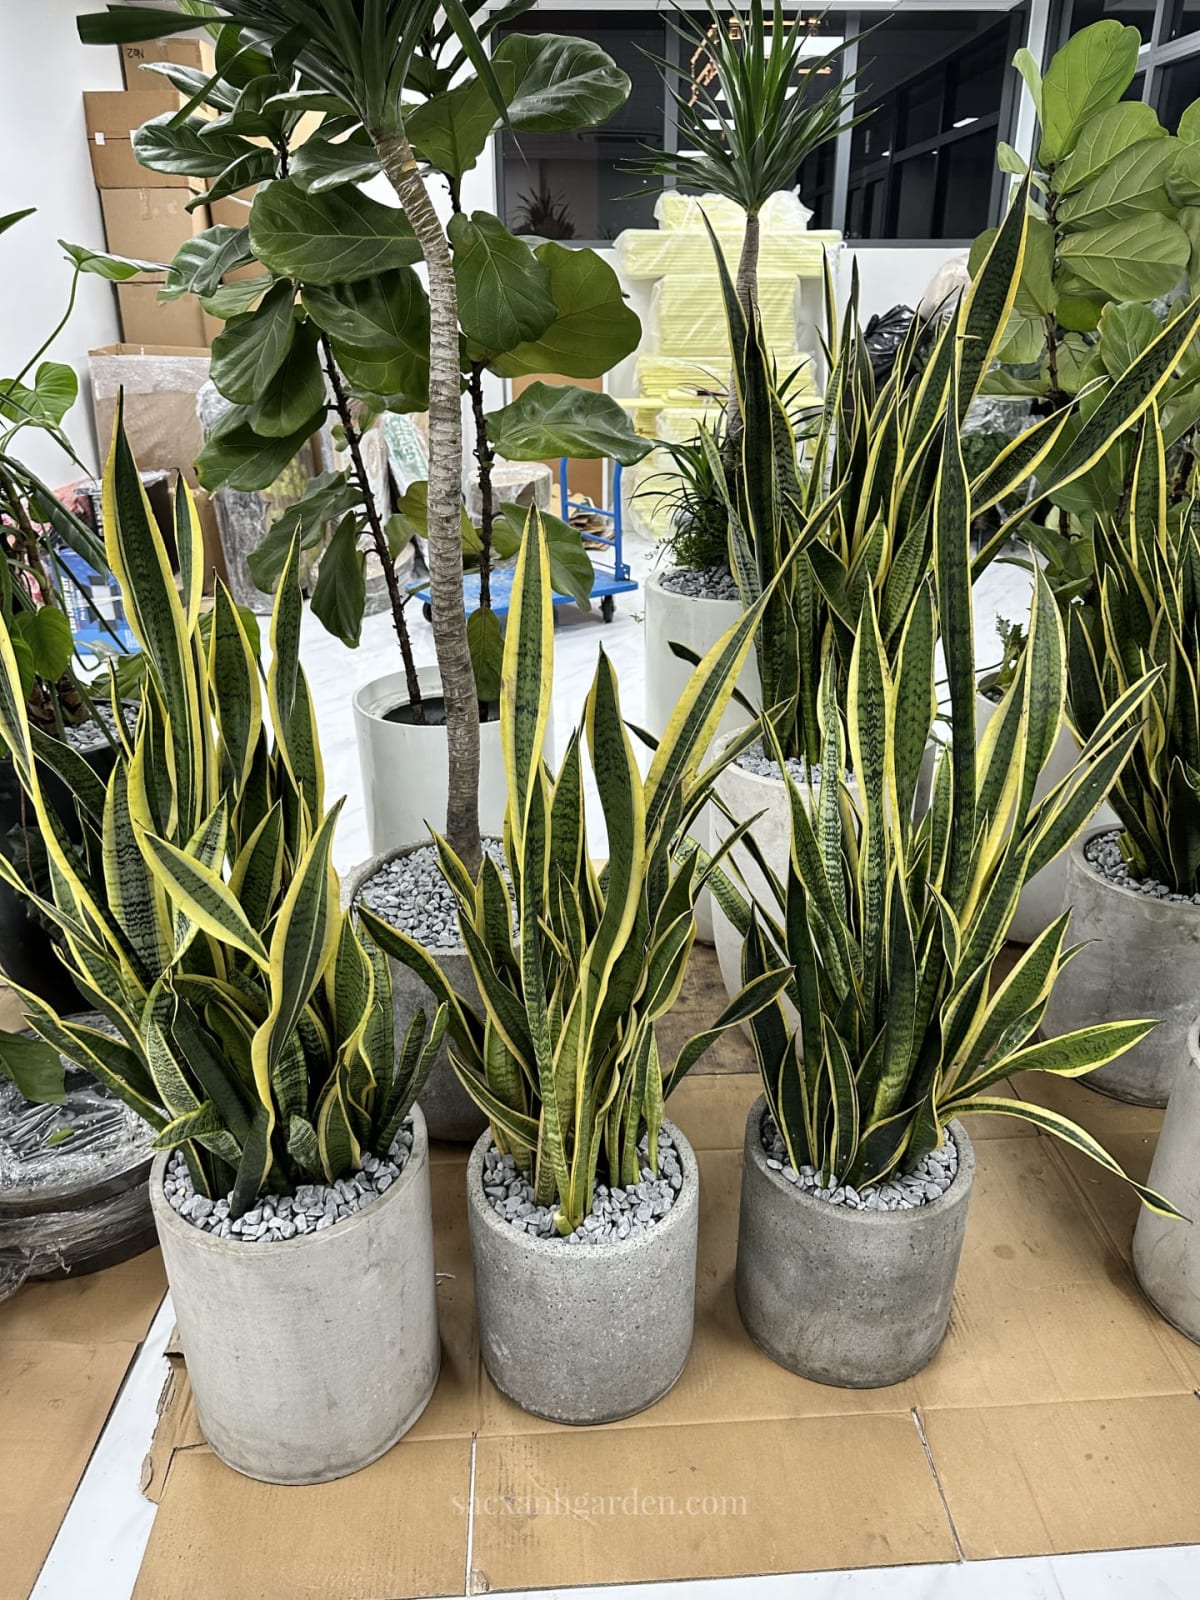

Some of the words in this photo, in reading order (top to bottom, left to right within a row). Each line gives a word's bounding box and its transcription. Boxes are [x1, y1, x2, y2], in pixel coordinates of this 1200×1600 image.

[61, 576, 70, 593] KIT
[64, 594, 74, 617] LIGHT
[69, 618, 78, 633] LED
